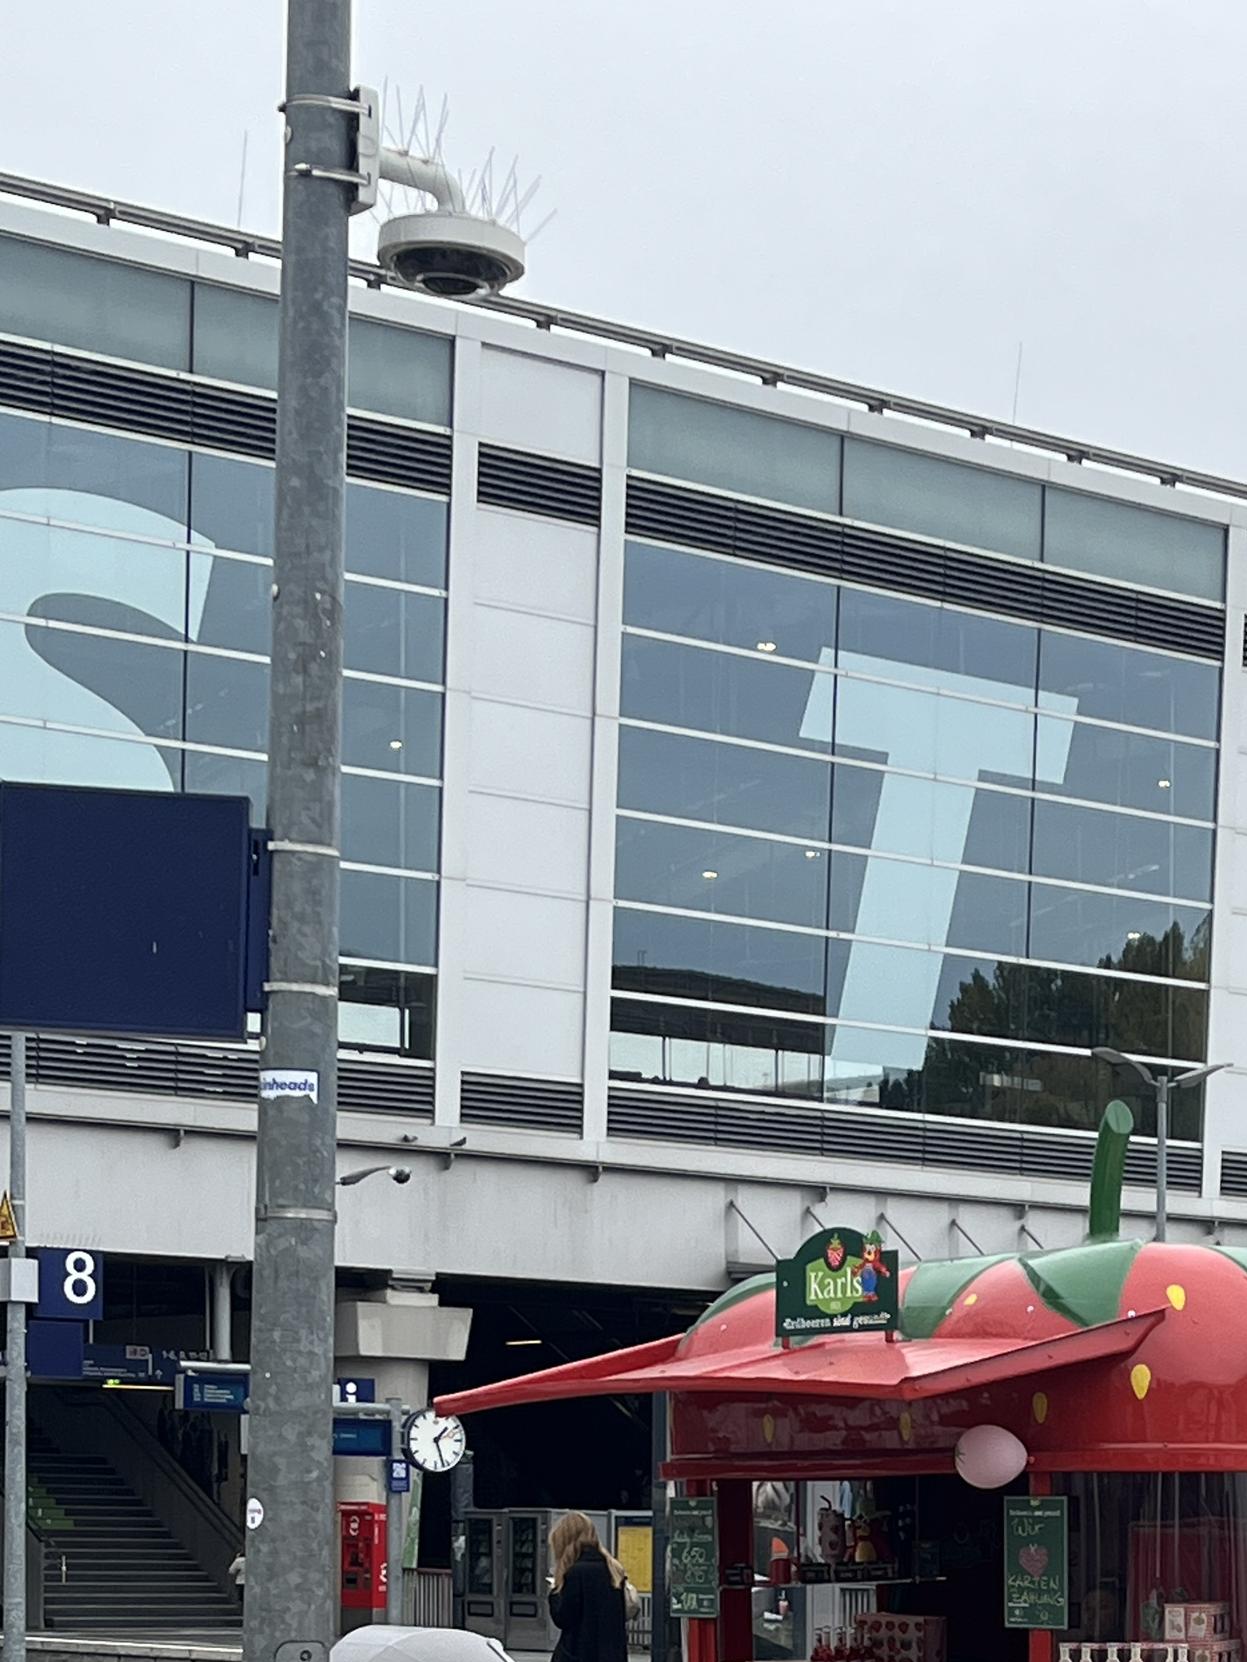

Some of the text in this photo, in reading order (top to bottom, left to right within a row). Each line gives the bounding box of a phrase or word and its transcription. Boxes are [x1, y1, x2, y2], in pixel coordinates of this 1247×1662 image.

[799, 646, 1078, 1070] T
[63, 1250, 96, 1304] 8
[809, 1266, 862, 1299] Karls
[1010, 1517, 1045, 1537] Wir
